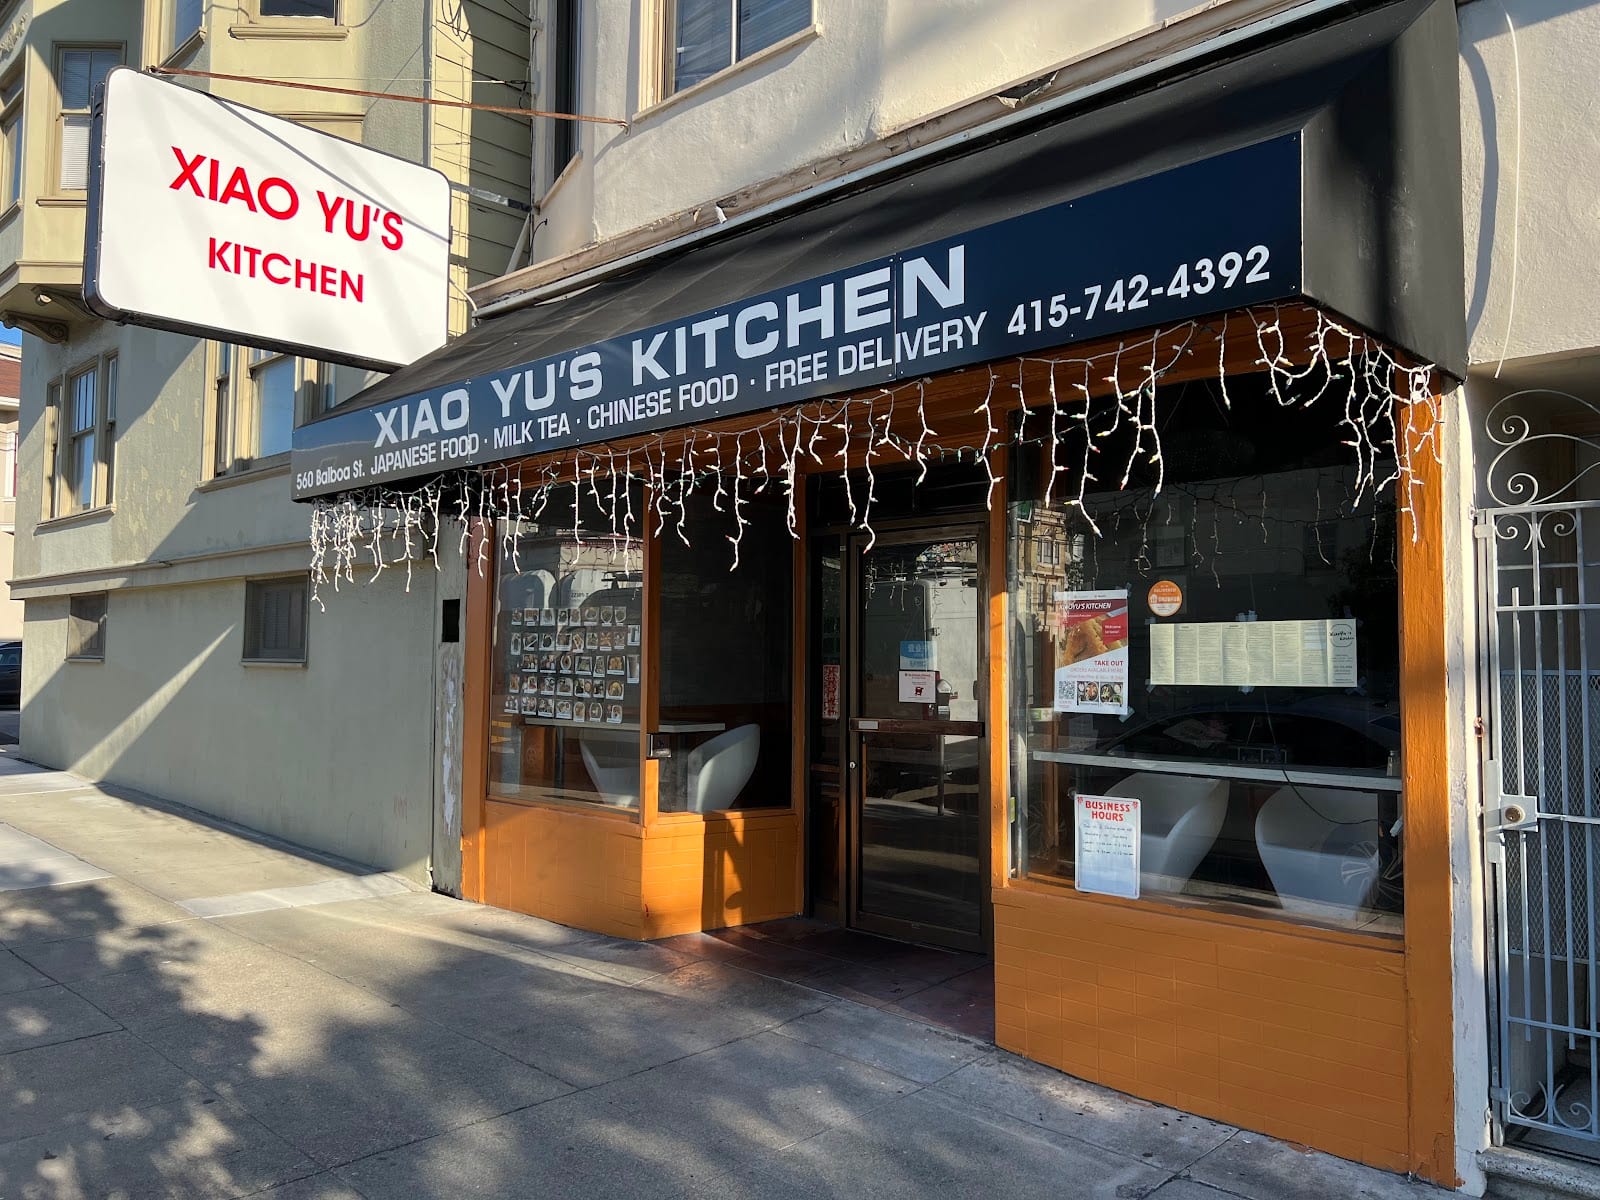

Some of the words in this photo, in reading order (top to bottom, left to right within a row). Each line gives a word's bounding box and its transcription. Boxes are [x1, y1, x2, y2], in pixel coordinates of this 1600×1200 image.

[169, 146, 299, 220] XIAO
[316, 190, 404, 251] YU'S
[208, 237, 364, 303] KITCHEN
[1007, 245, 1270, 335] 415-742-4392
[374, 388, 470, 448] XIAO
[490, 351, 603, 418] YU'S
[632, 244, 965, 387] KITCHEN
[371, 442, 436, 475] JAPANESE
[440, 433, 479, 461] FOOD
[493, 422, 534, 450] MILK
[537, 412, 570, 440] TEA
[587, 387, 672, 430] CHINESE
[678, 373, 738, 410] FOOD
[765, 350, 828, 392] FREE
[838, 311, 988, 377] DELIVERY
[296, 470, 314, 490] 560
[316, 466, 350, 486] Balboa
[353, 459, 366, 478] St.
[1086, 602, 1112, 610] KITCHEN
[1091, 811, 1124, 822] HOURS
